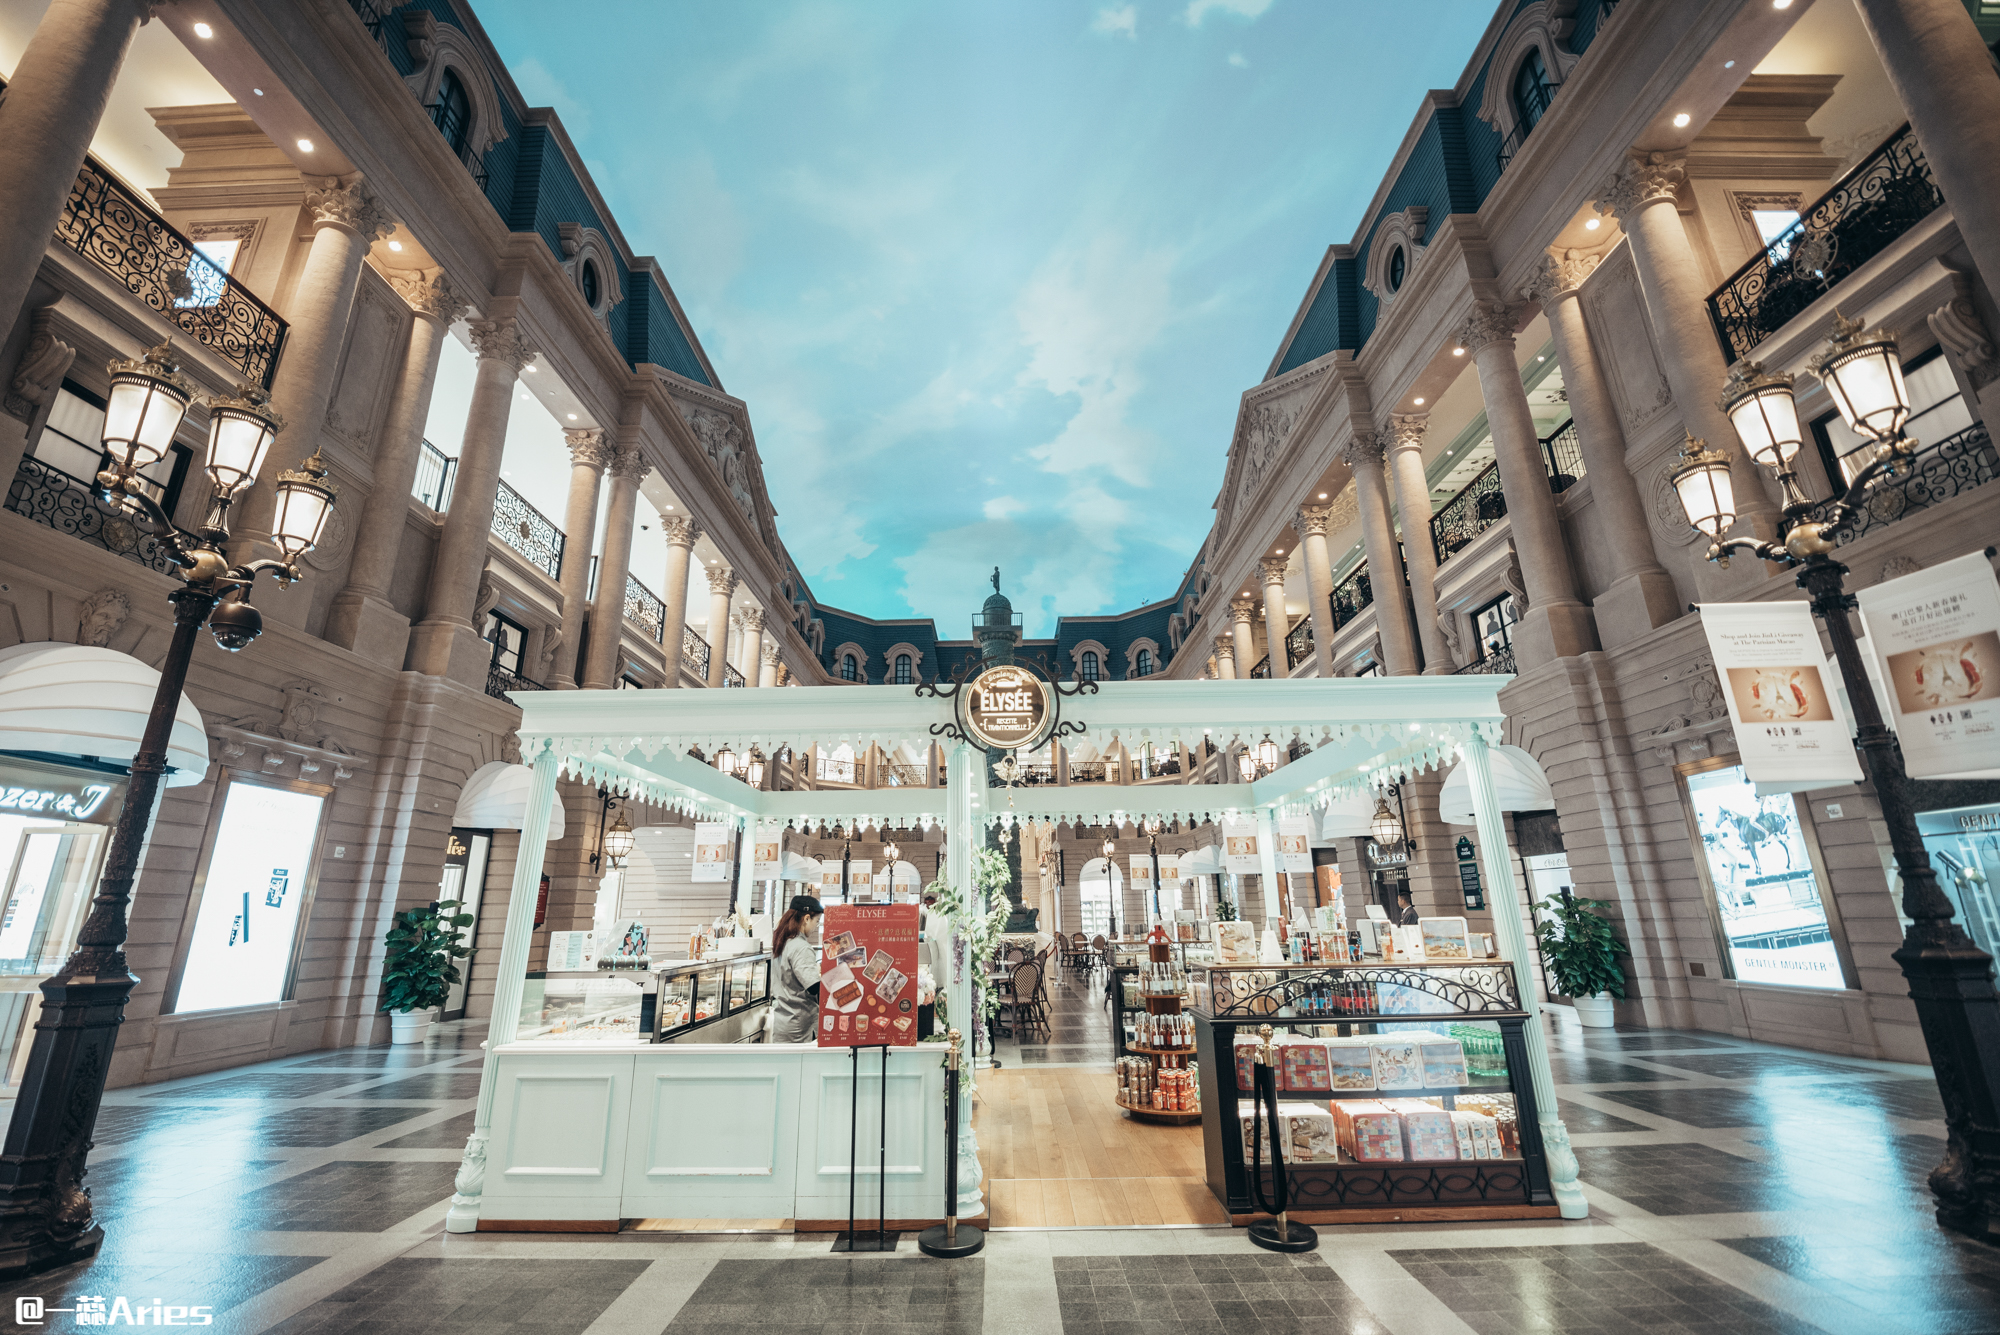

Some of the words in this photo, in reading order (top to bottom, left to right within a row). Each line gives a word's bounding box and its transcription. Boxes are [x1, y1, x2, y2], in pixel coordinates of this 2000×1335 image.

[1720, 633, 1736, 641] Shop
[1778, 631, 1804, 639] Giveaway
[980, 689, 1033, 711] ÉLYSÉE
[52, 794, 77, 812] &
[1960, 812, 2000, 831] GENT
[857, 908, 887, 918] ÉLYSÉE
[1744, 958, 1778, 969] GENTLE
[1780, 960, 1827, 972] MONSTER
